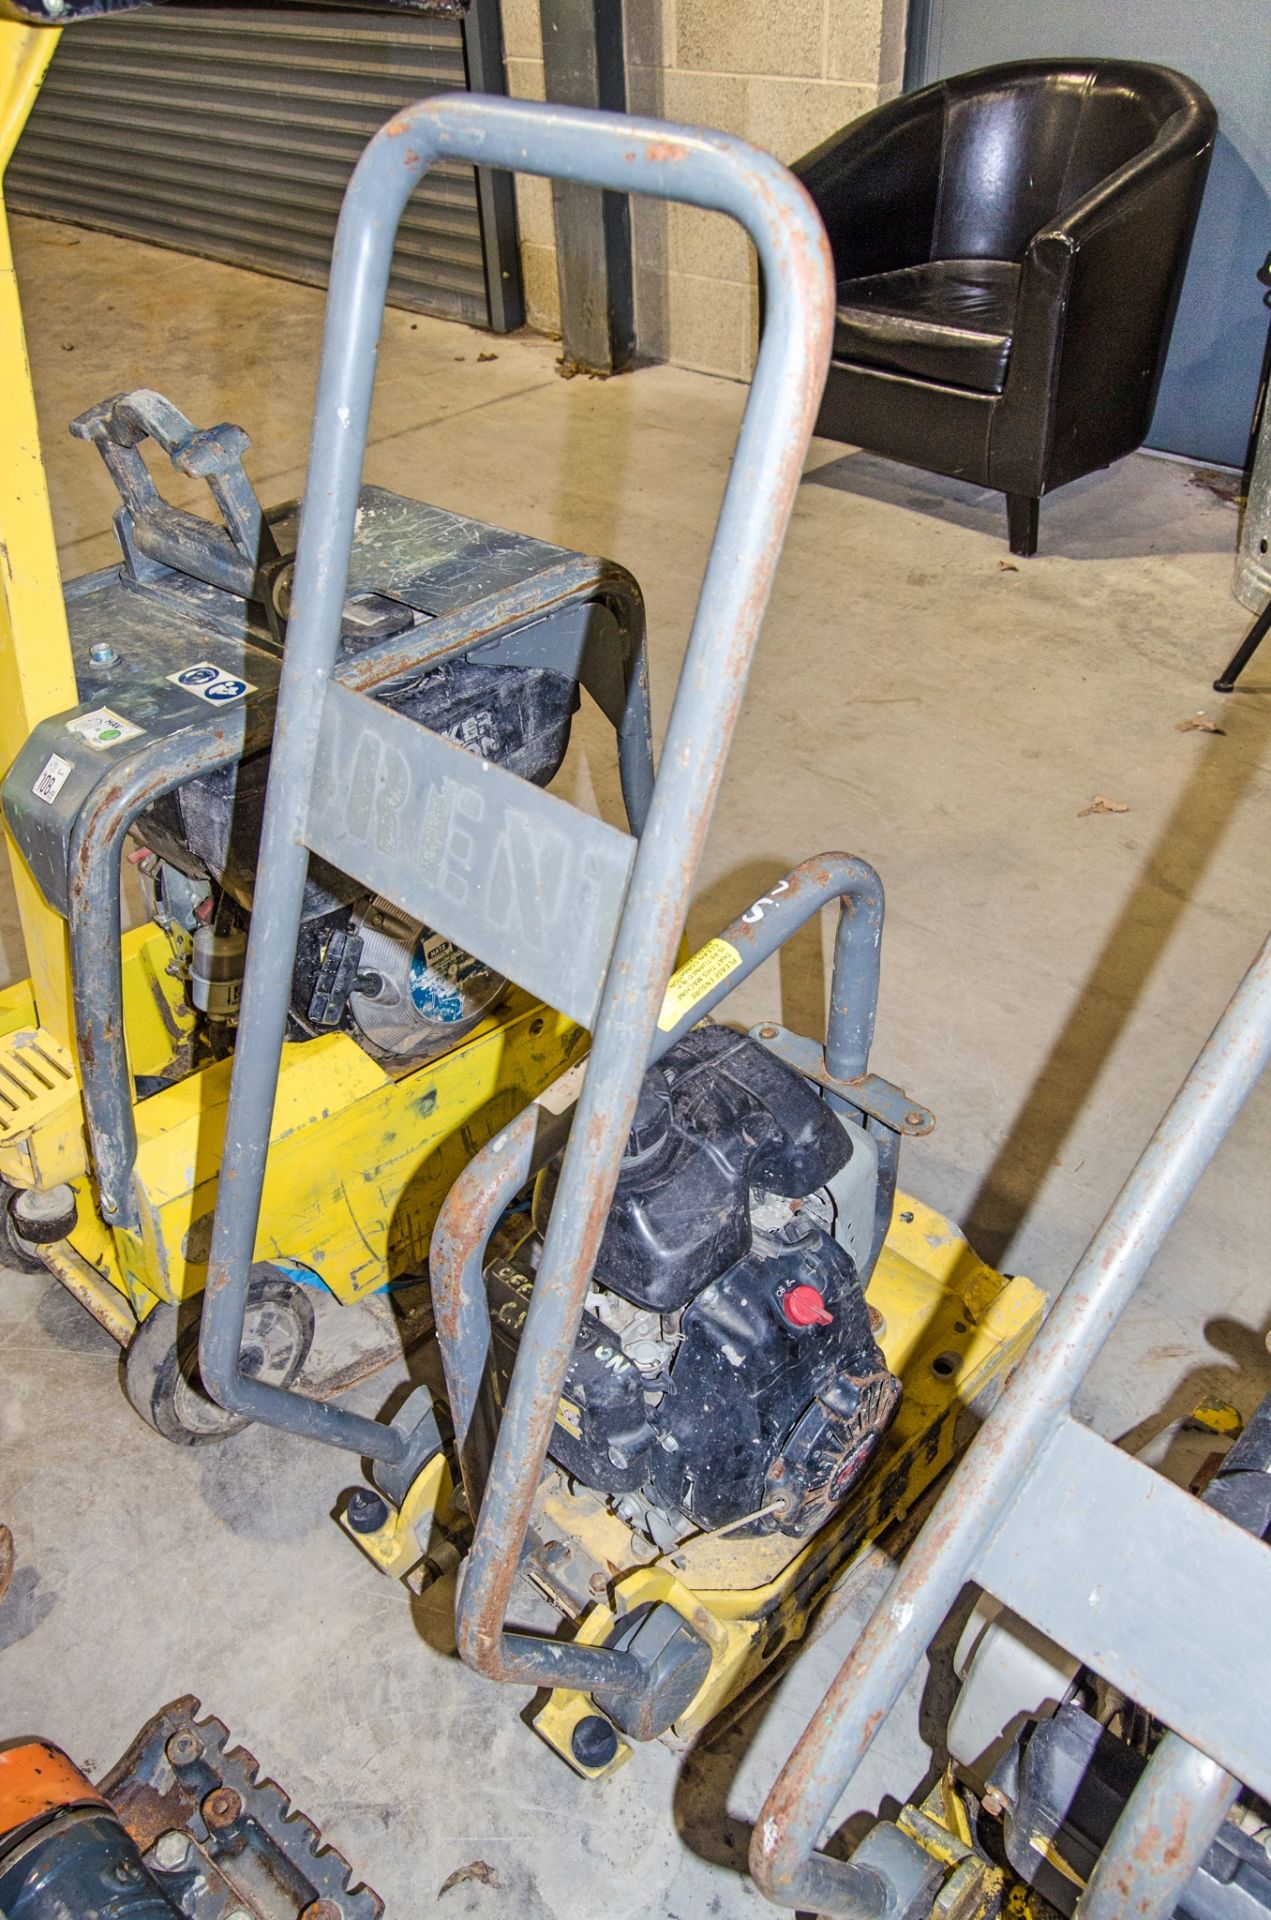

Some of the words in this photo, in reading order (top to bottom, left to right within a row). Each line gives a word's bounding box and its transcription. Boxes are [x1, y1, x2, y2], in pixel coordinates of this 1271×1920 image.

[37, 773, 55, 795] 108
[714, 958, 737, 979] PLEASE
[716, 952, 731, 967] THAT
[702, 965, 716, 979] THIS
[676, 976, 703, 1000] MACHINE
[690, 977, 715, 1000] ENSURE
